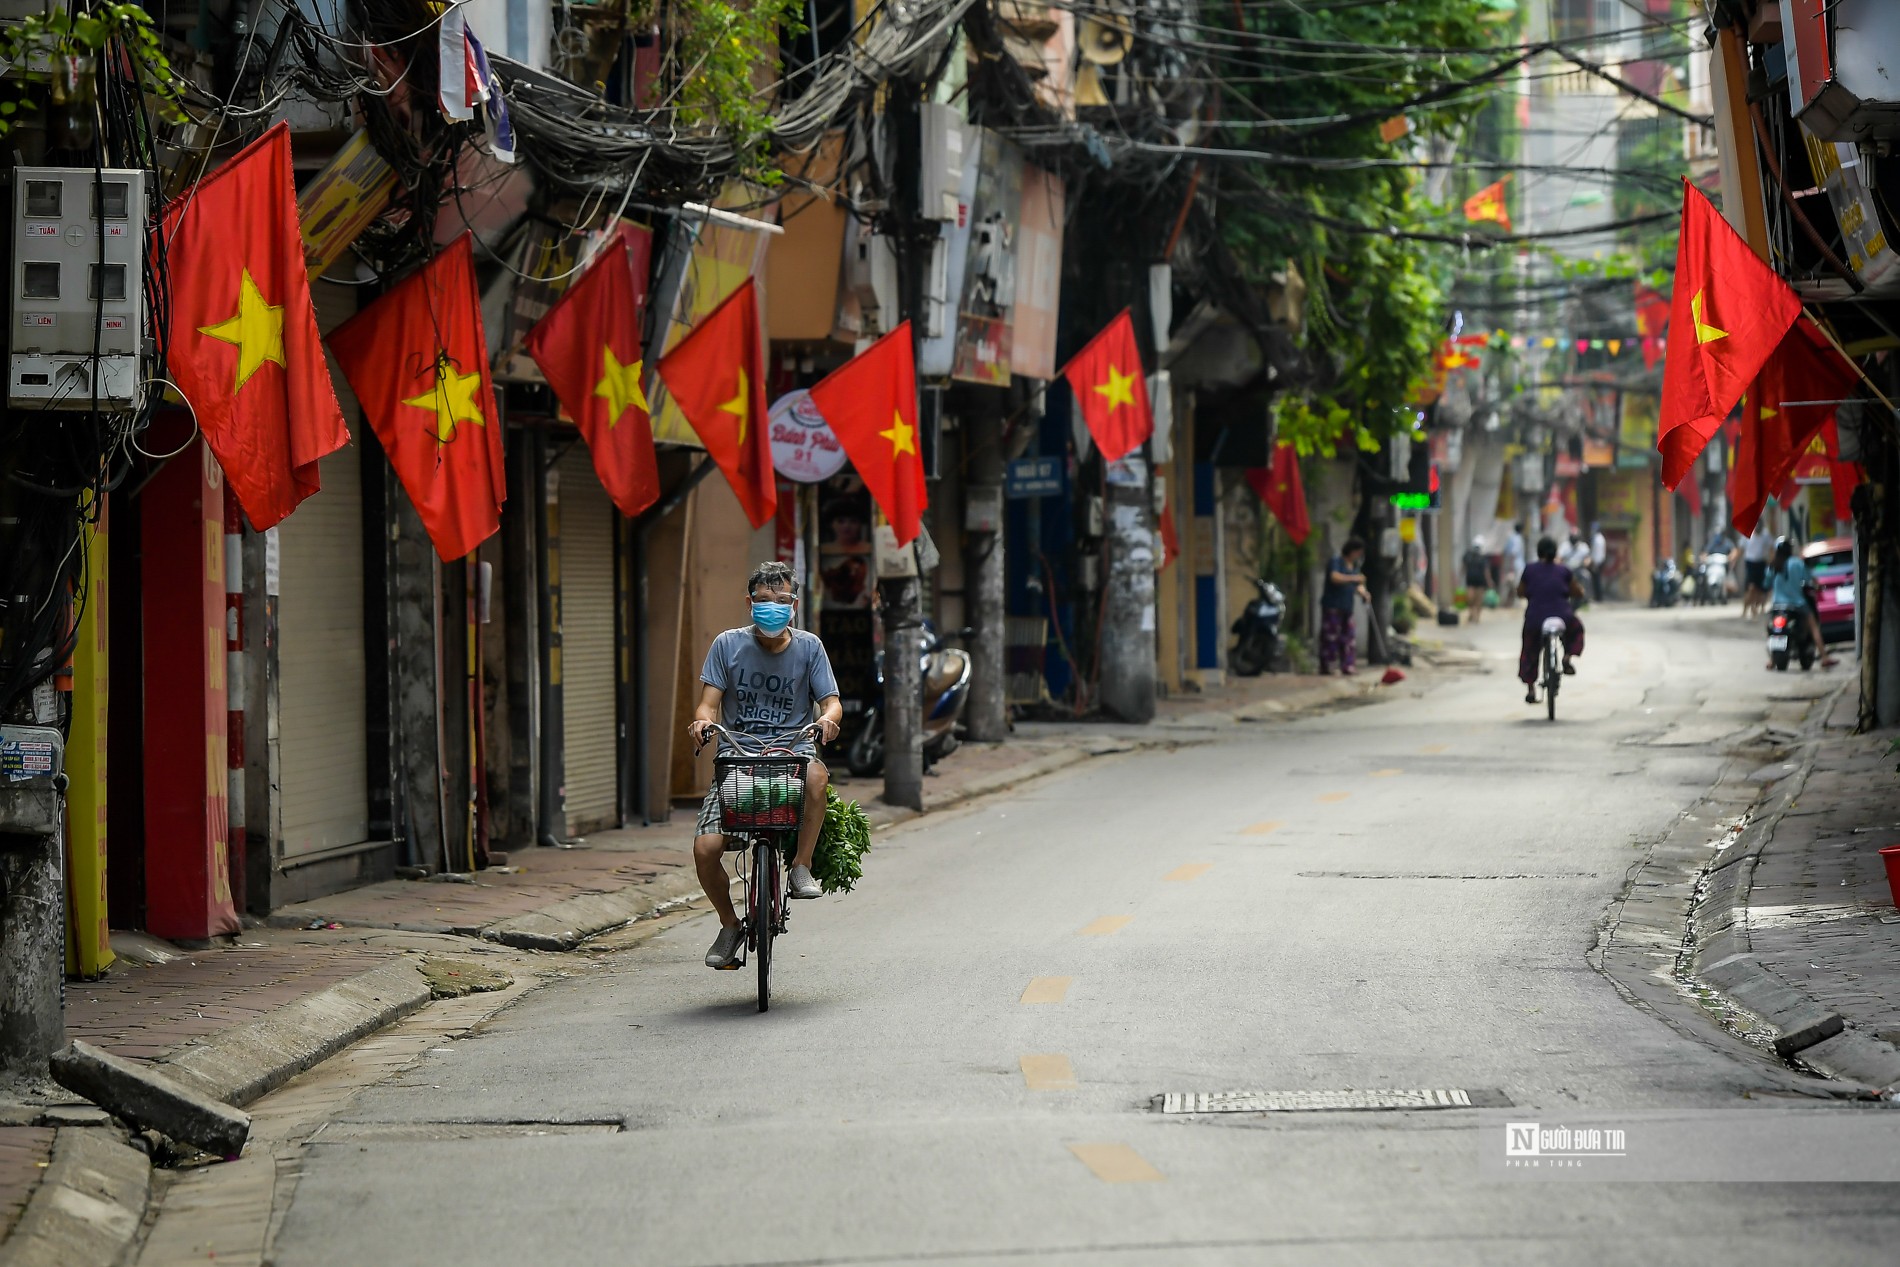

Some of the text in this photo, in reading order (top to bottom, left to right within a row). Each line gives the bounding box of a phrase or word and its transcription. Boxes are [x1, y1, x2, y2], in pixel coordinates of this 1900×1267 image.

[738, 668, 796, 695] LOOK
[737, 689, 794, 711] ON THE
[737, 704, 790, 724] BRIGHT
